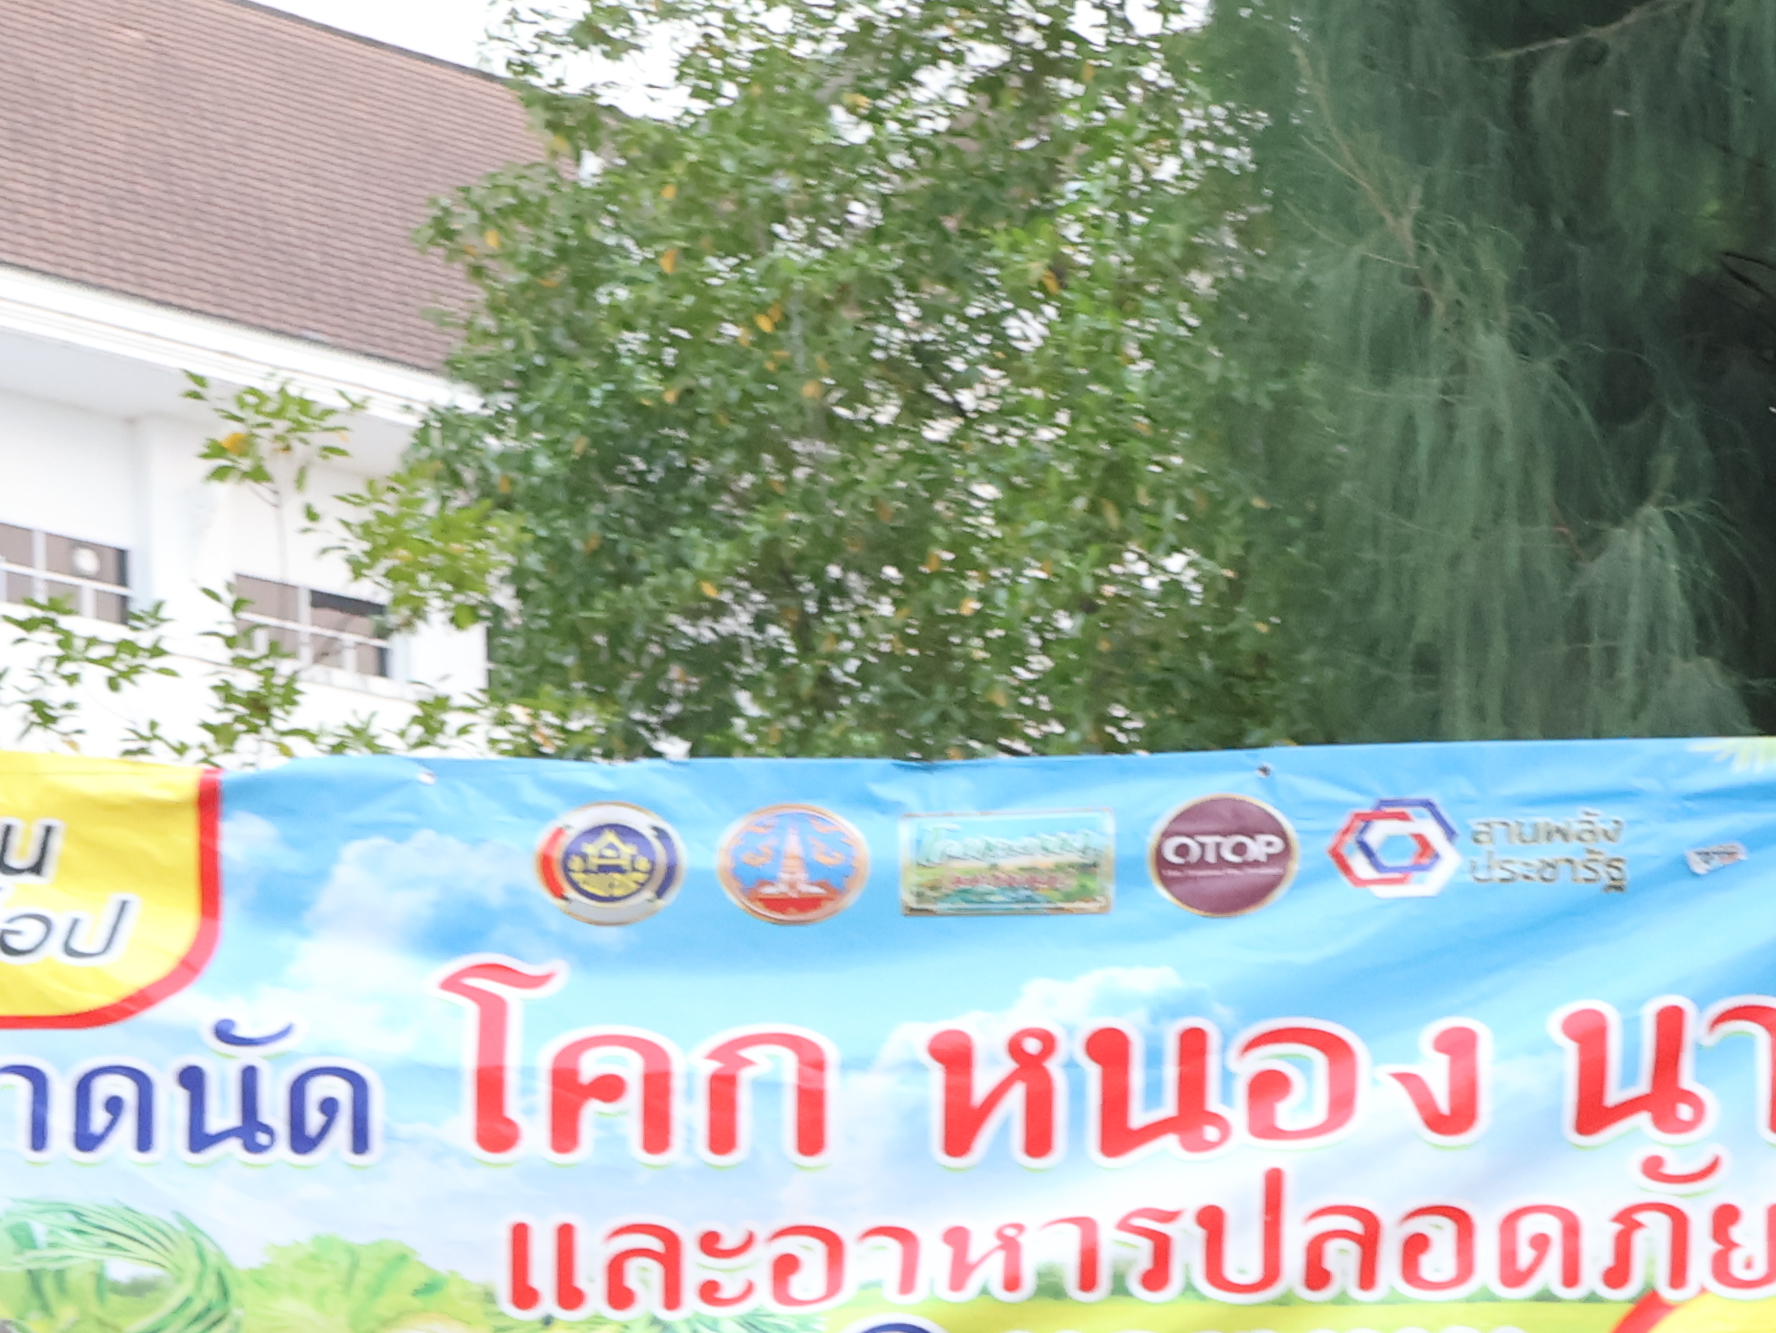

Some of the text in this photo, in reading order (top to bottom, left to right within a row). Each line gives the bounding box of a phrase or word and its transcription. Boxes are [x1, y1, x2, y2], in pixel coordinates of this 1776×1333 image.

[1161, 833, 1285, 864] OTOP
[439, 960, 827, 1158] โคก
[926, 1022, 1484, 1163] หนอง
